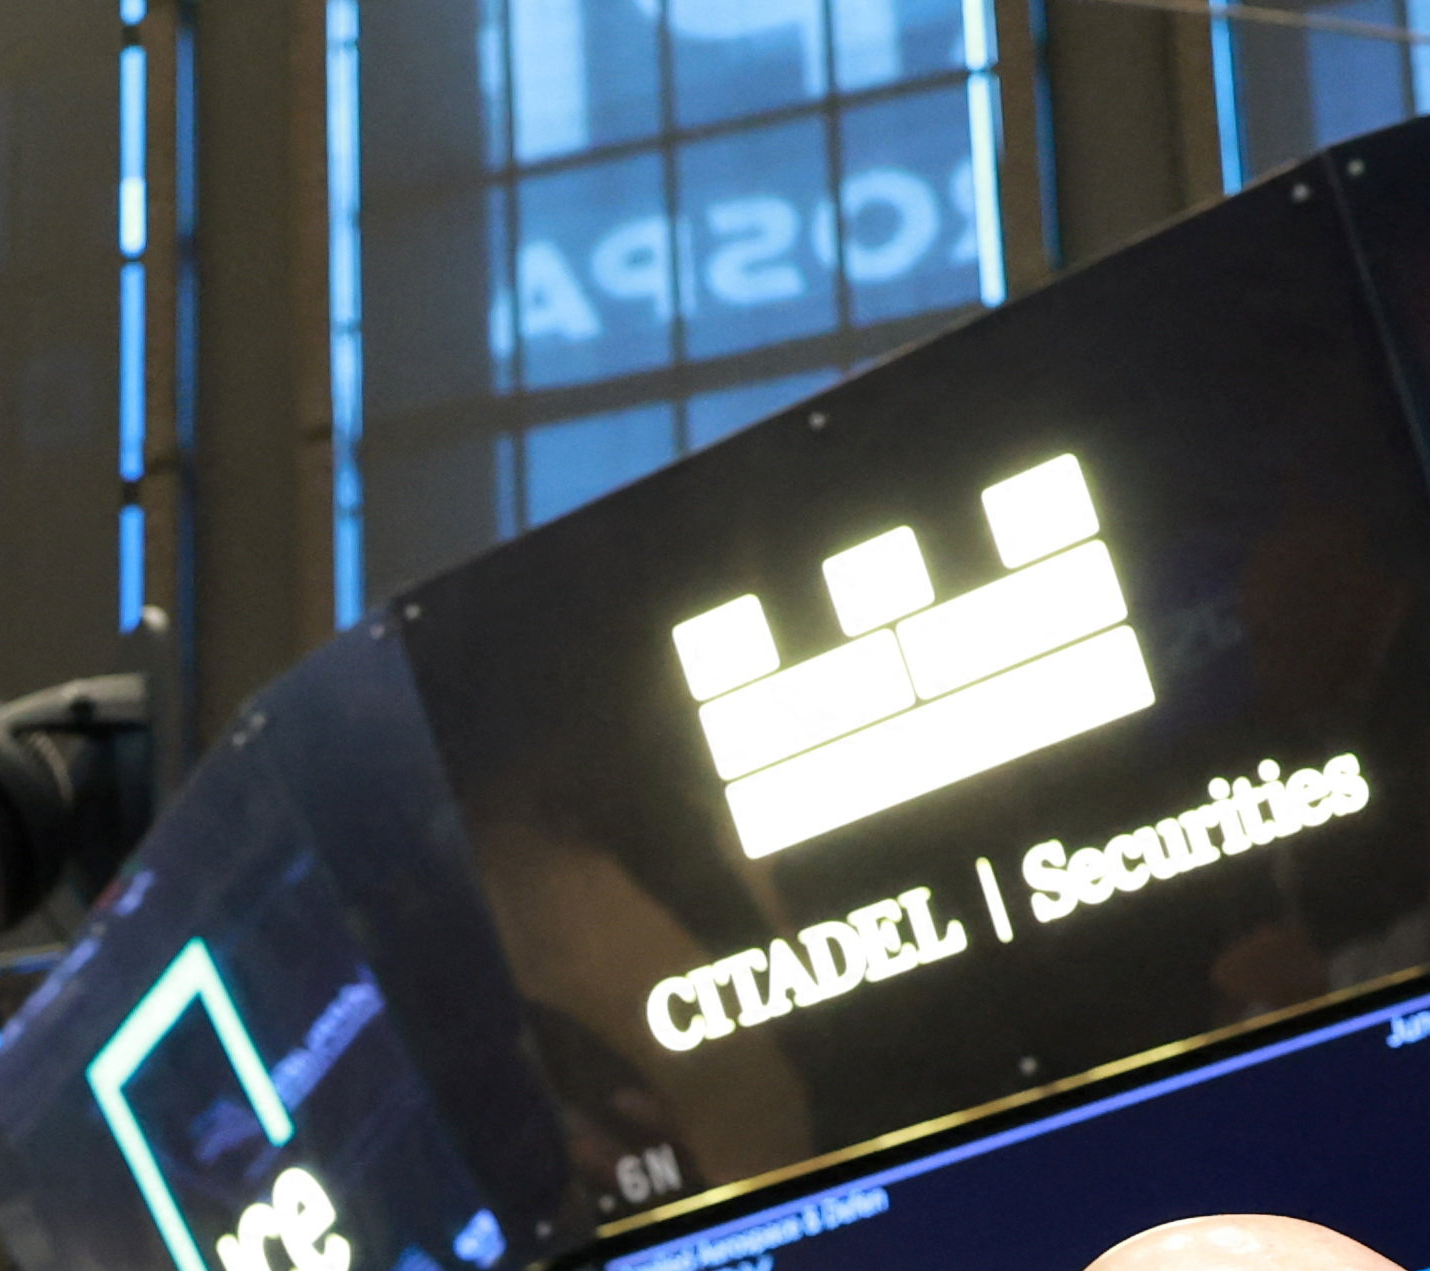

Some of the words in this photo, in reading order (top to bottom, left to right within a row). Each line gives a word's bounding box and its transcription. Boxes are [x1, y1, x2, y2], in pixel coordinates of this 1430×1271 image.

[647, 886, 969, 1051] CITADEL
[1021, 752, 1371, 923] Securities
[616, 1144, 682, 1203] 6N
